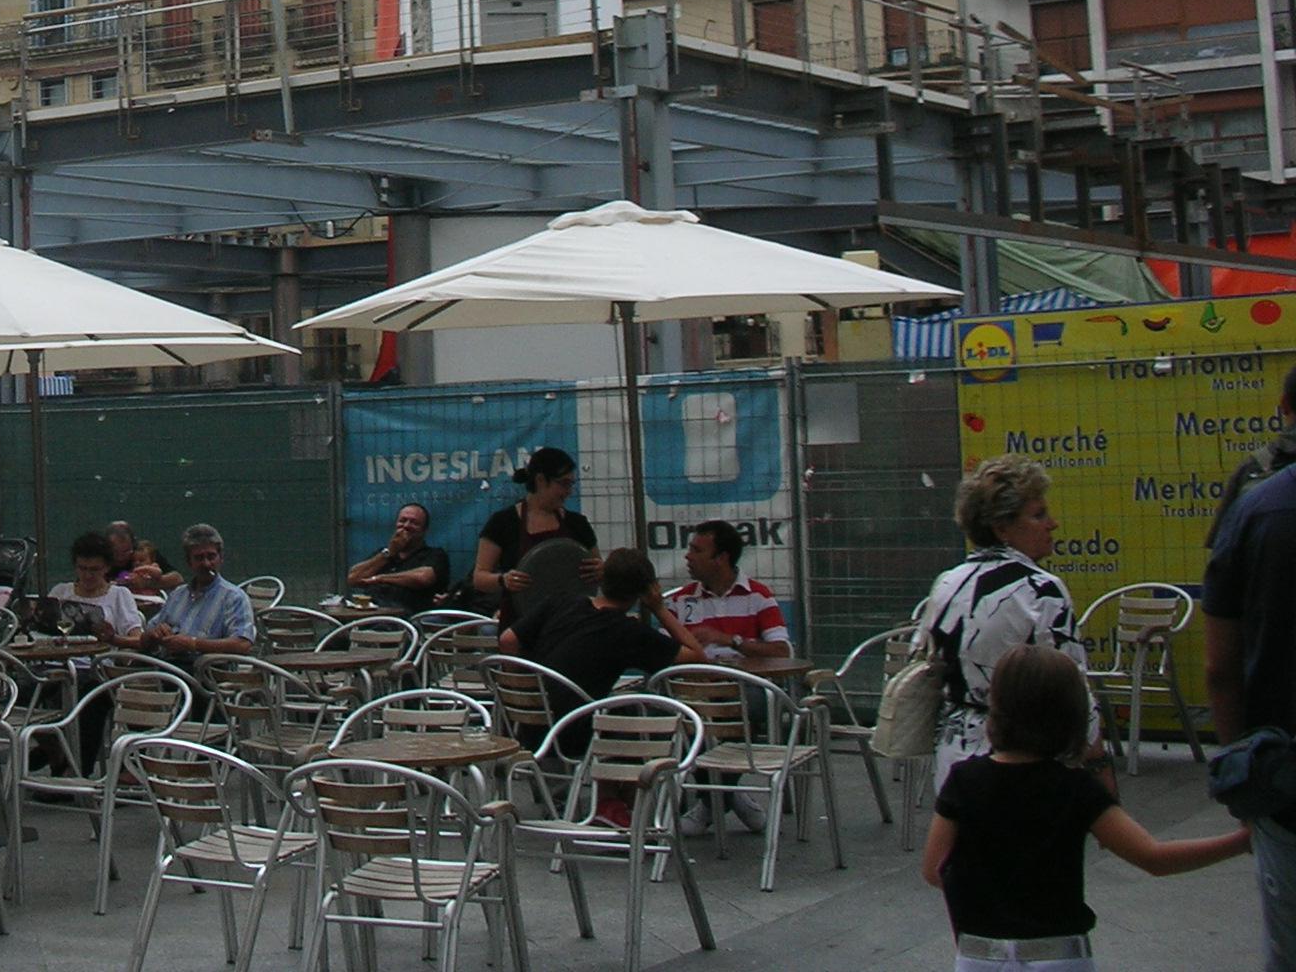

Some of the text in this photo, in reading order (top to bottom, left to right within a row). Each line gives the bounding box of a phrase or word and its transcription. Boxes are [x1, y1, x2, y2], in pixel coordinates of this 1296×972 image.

[1212, 378, 1265, 392] Market
[1175, 405, 1282, 437] Mercad
[1006, 425, 1108, 455] Marché
[1053, 529, 1120, 556] cado
